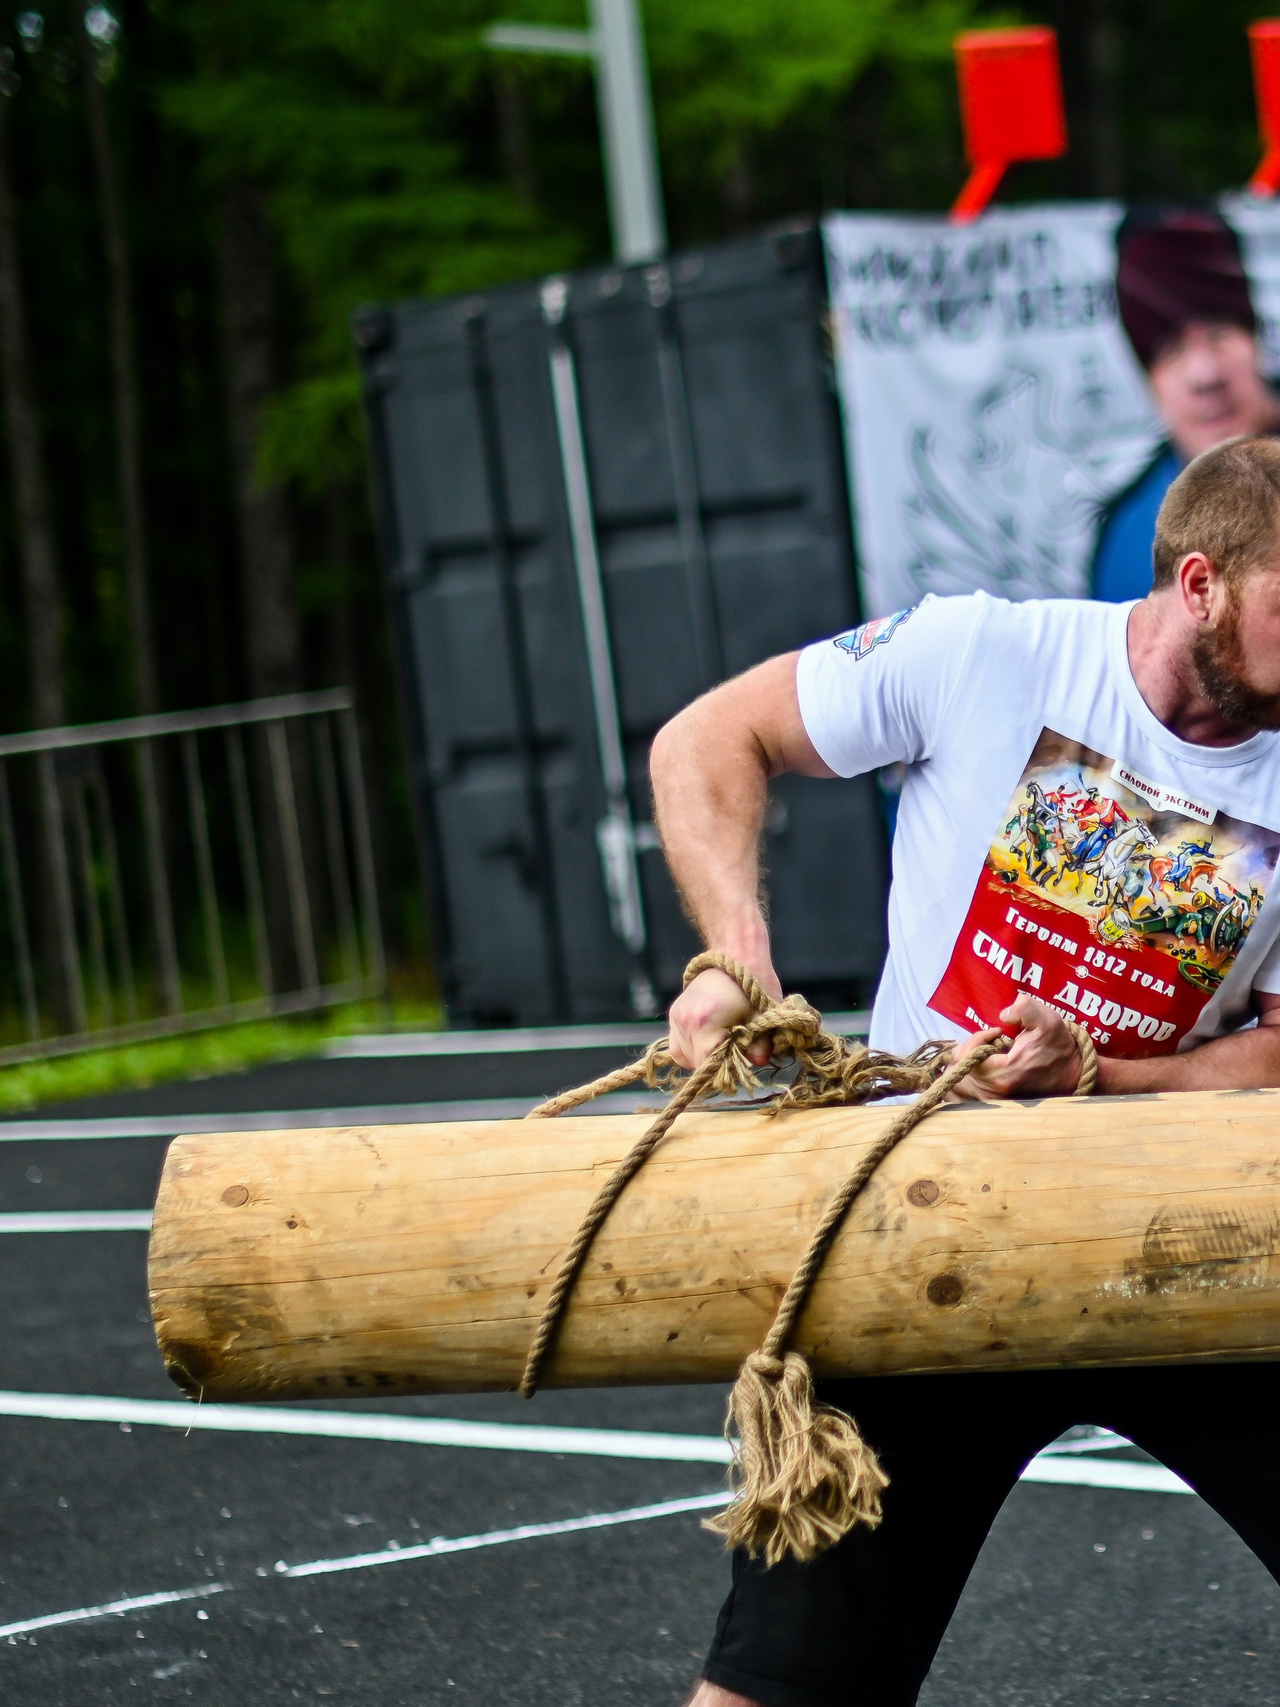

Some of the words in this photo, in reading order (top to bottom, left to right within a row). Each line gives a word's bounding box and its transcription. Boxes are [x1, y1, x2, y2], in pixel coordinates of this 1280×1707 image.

[1119, 769, 1161, 798] СИЛОВОЙ
[1163, 793, 1210, 819] ЭКСТРИМ
[1083, 946, 1128, 977] 1812
[972, 929, 1044, 990] СИЛА
[1053, 981, 1177, 1042] ДВОРОВ
[1090, 1026, 1113, 1045] 26
